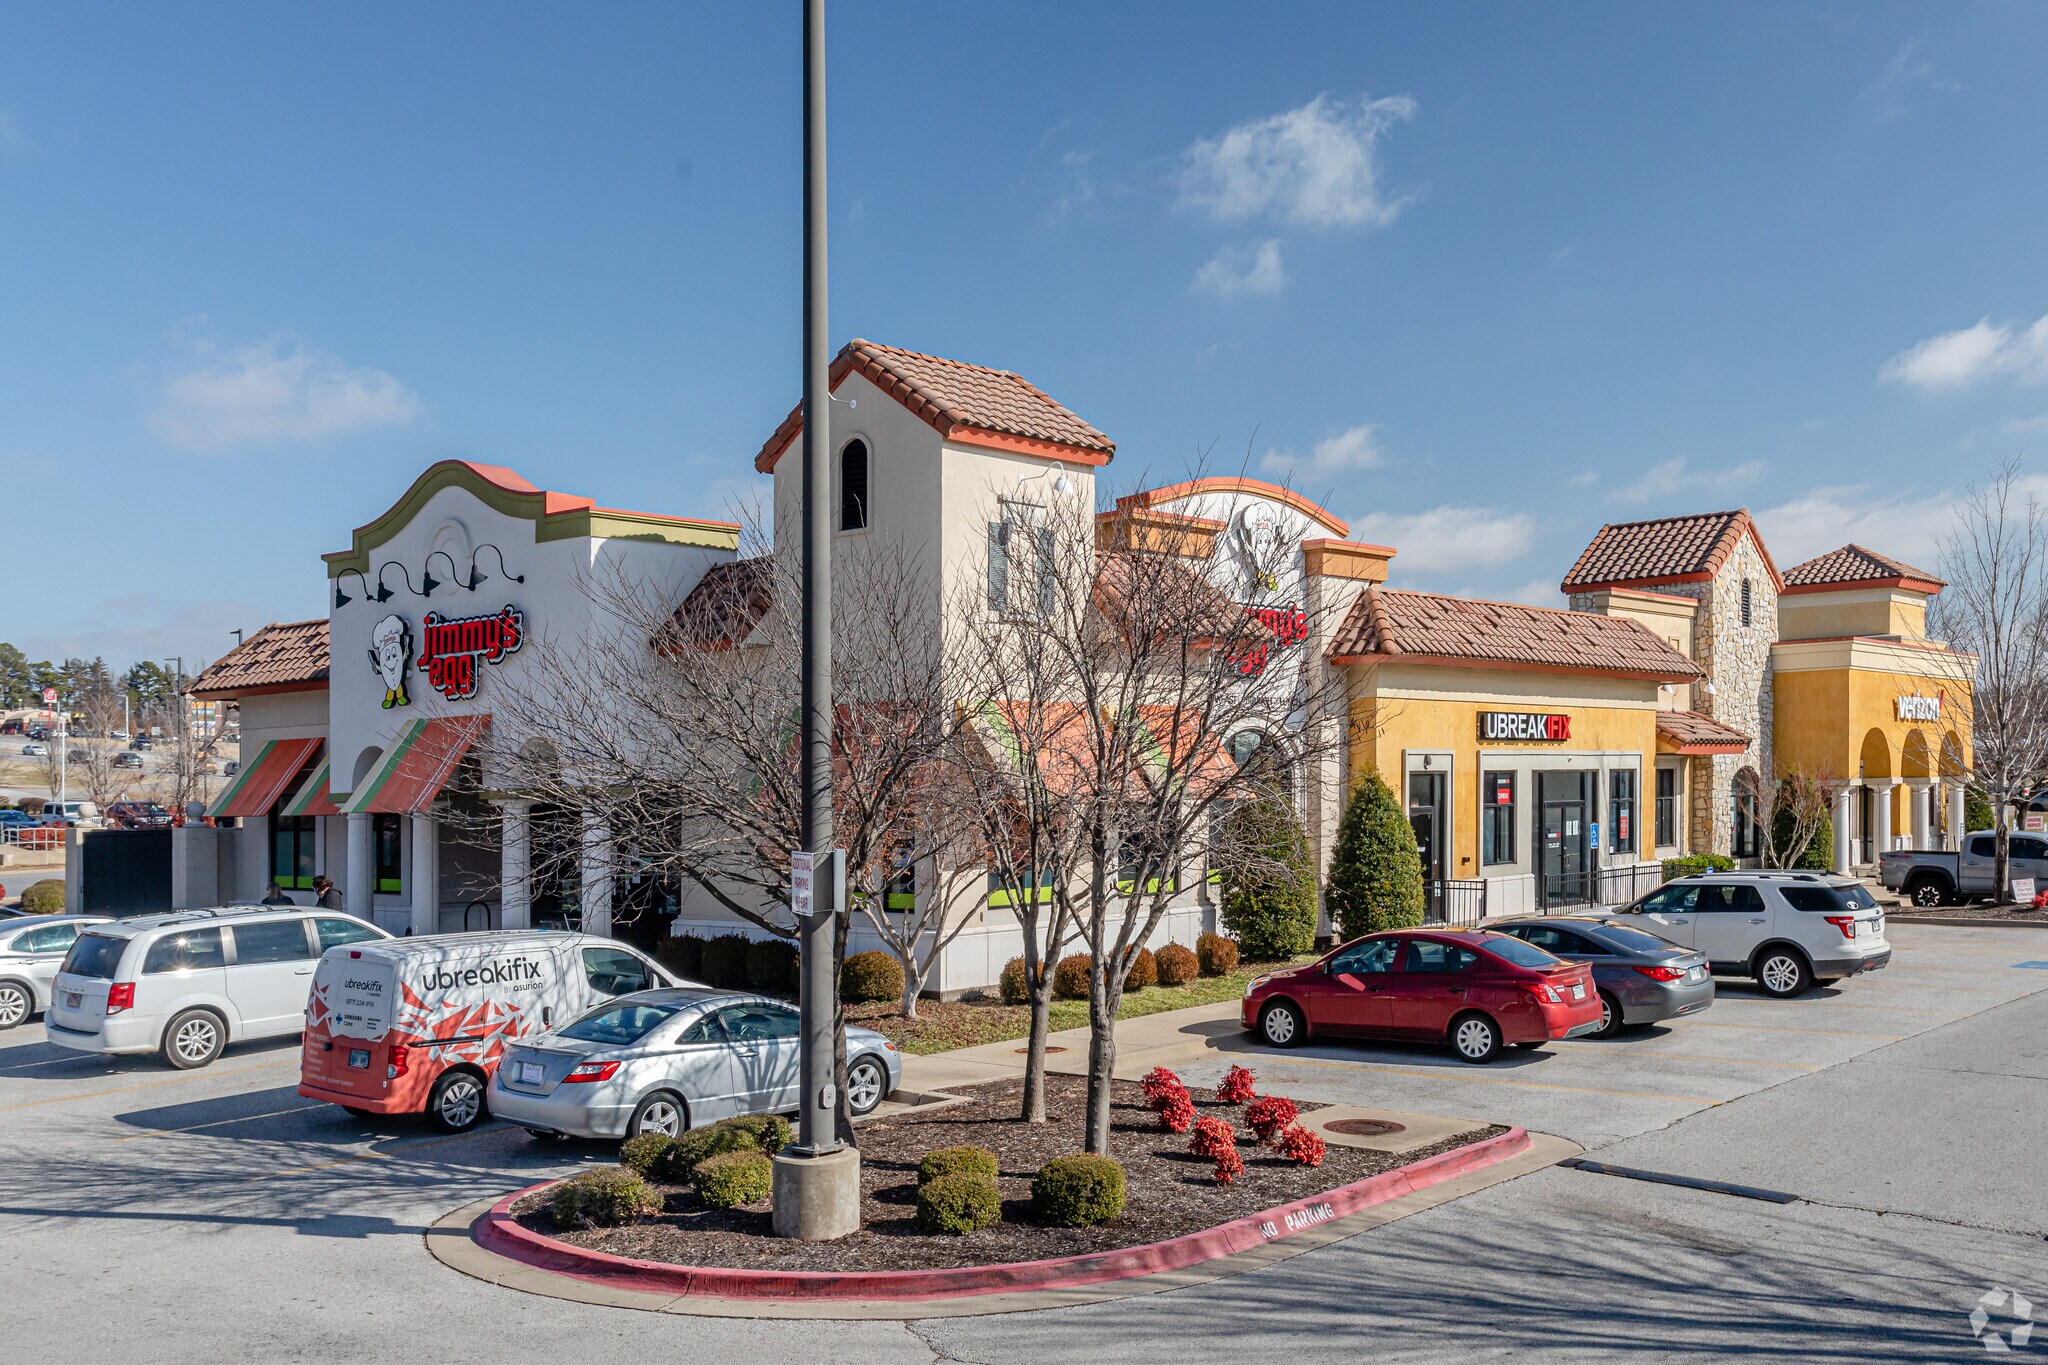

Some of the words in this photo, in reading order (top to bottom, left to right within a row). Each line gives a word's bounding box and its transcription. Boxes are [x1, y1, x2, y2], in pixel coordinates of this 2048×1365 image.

[417, 608, 517, 667] jimmy's
[429, 654, 472, 696] egg
[1898, 689, 1940, 720] verizon
[1487, 713, 1572, 740] UBREAKIFIX
[792, 857, 812, 871] ADDITIONAL
[794, 876, 809, 890] PARKING
[344, 978, 383, 993] ubreakifix
[422, 956, 542, 992] ubreakifix
[513, 981, 544, 992] asurion
[1259, 1221, 1278, 1238] NO
[1284, 1203, 1335, 1231] PARKING
